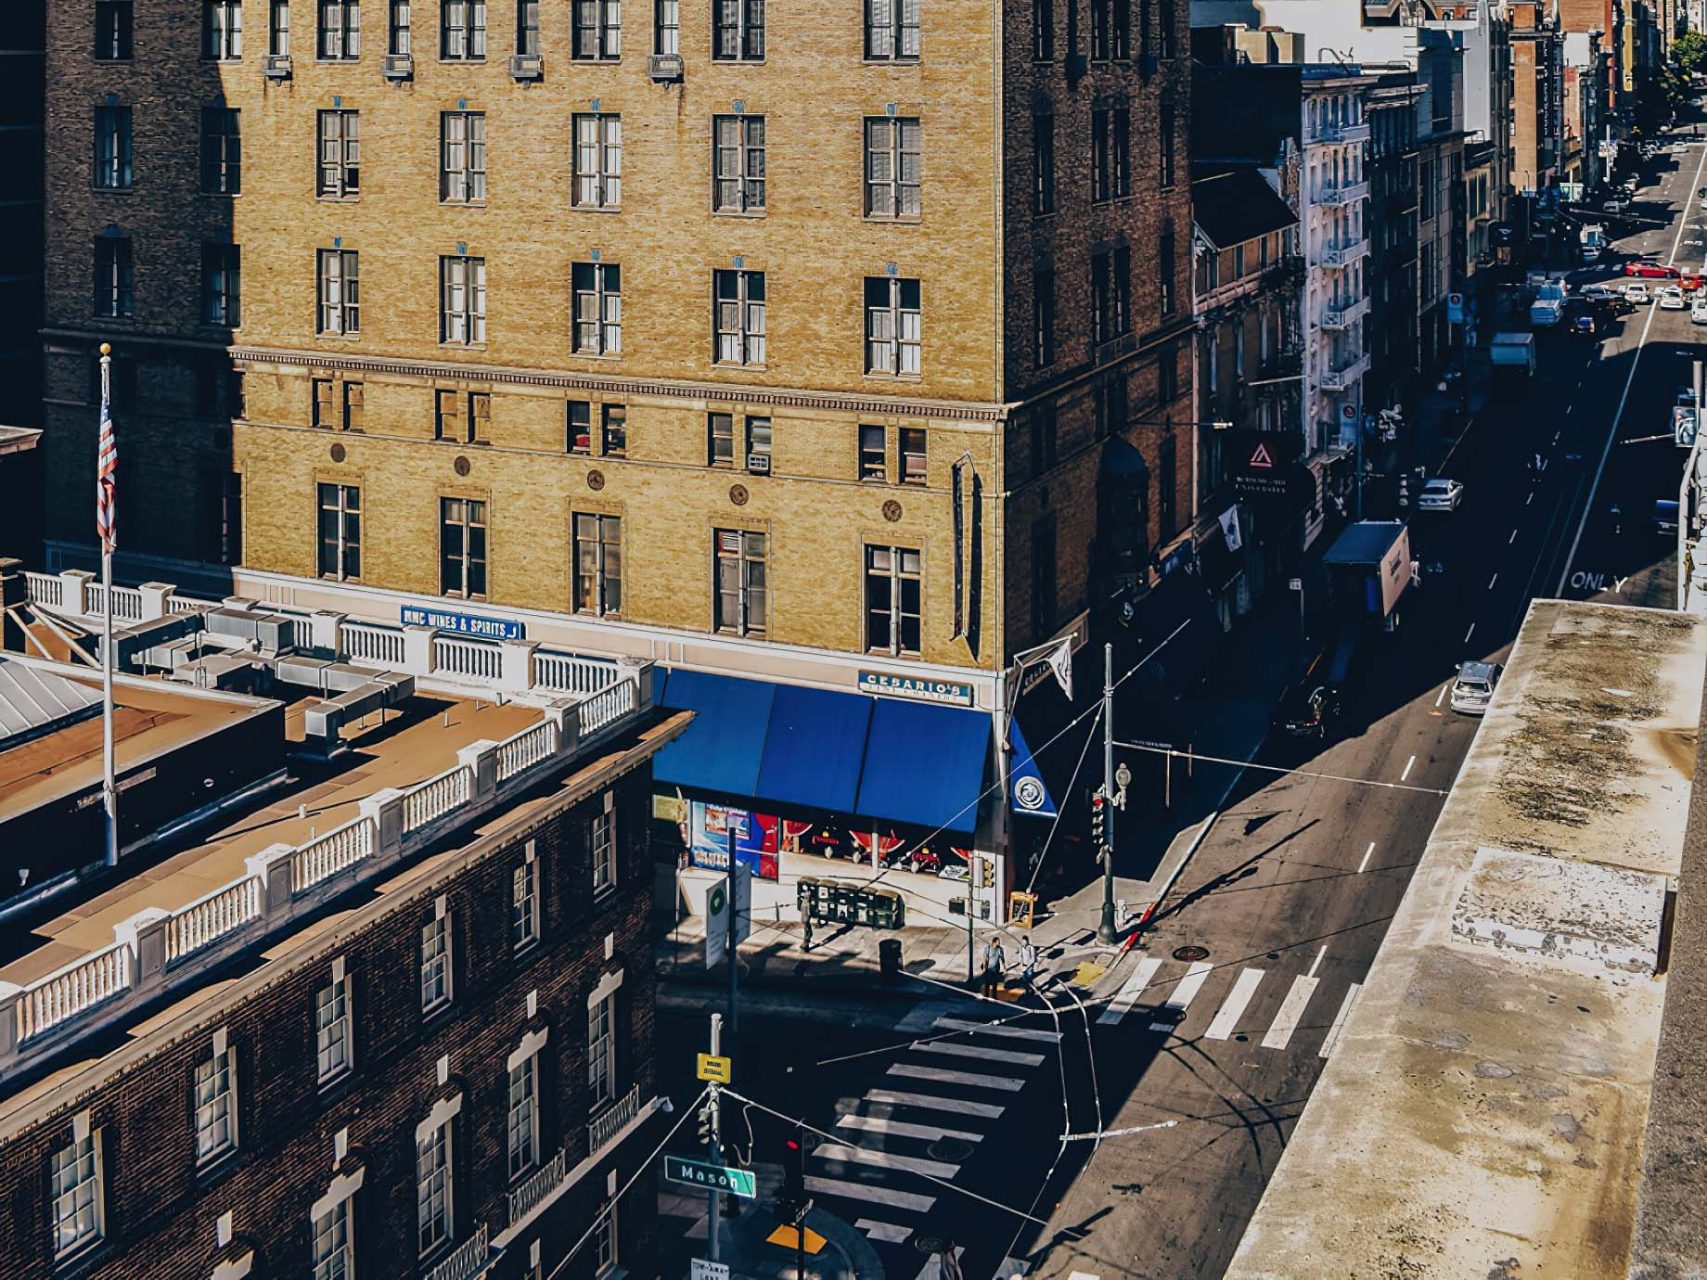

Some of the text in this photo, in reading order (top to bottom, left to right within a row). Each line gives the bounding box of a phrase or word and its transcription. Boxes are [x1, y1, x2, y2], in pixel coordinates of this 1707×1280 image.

[1571, 571, 1628, 594] ONLY
[428, 613, 457, 629] WINES
[460, 618, 467, 631] &
[471, 619, 505, 637] SPIRITS
[867, 674, 961, 696] CESARIO'S
[681, 1165, 739, 1191] Mason
